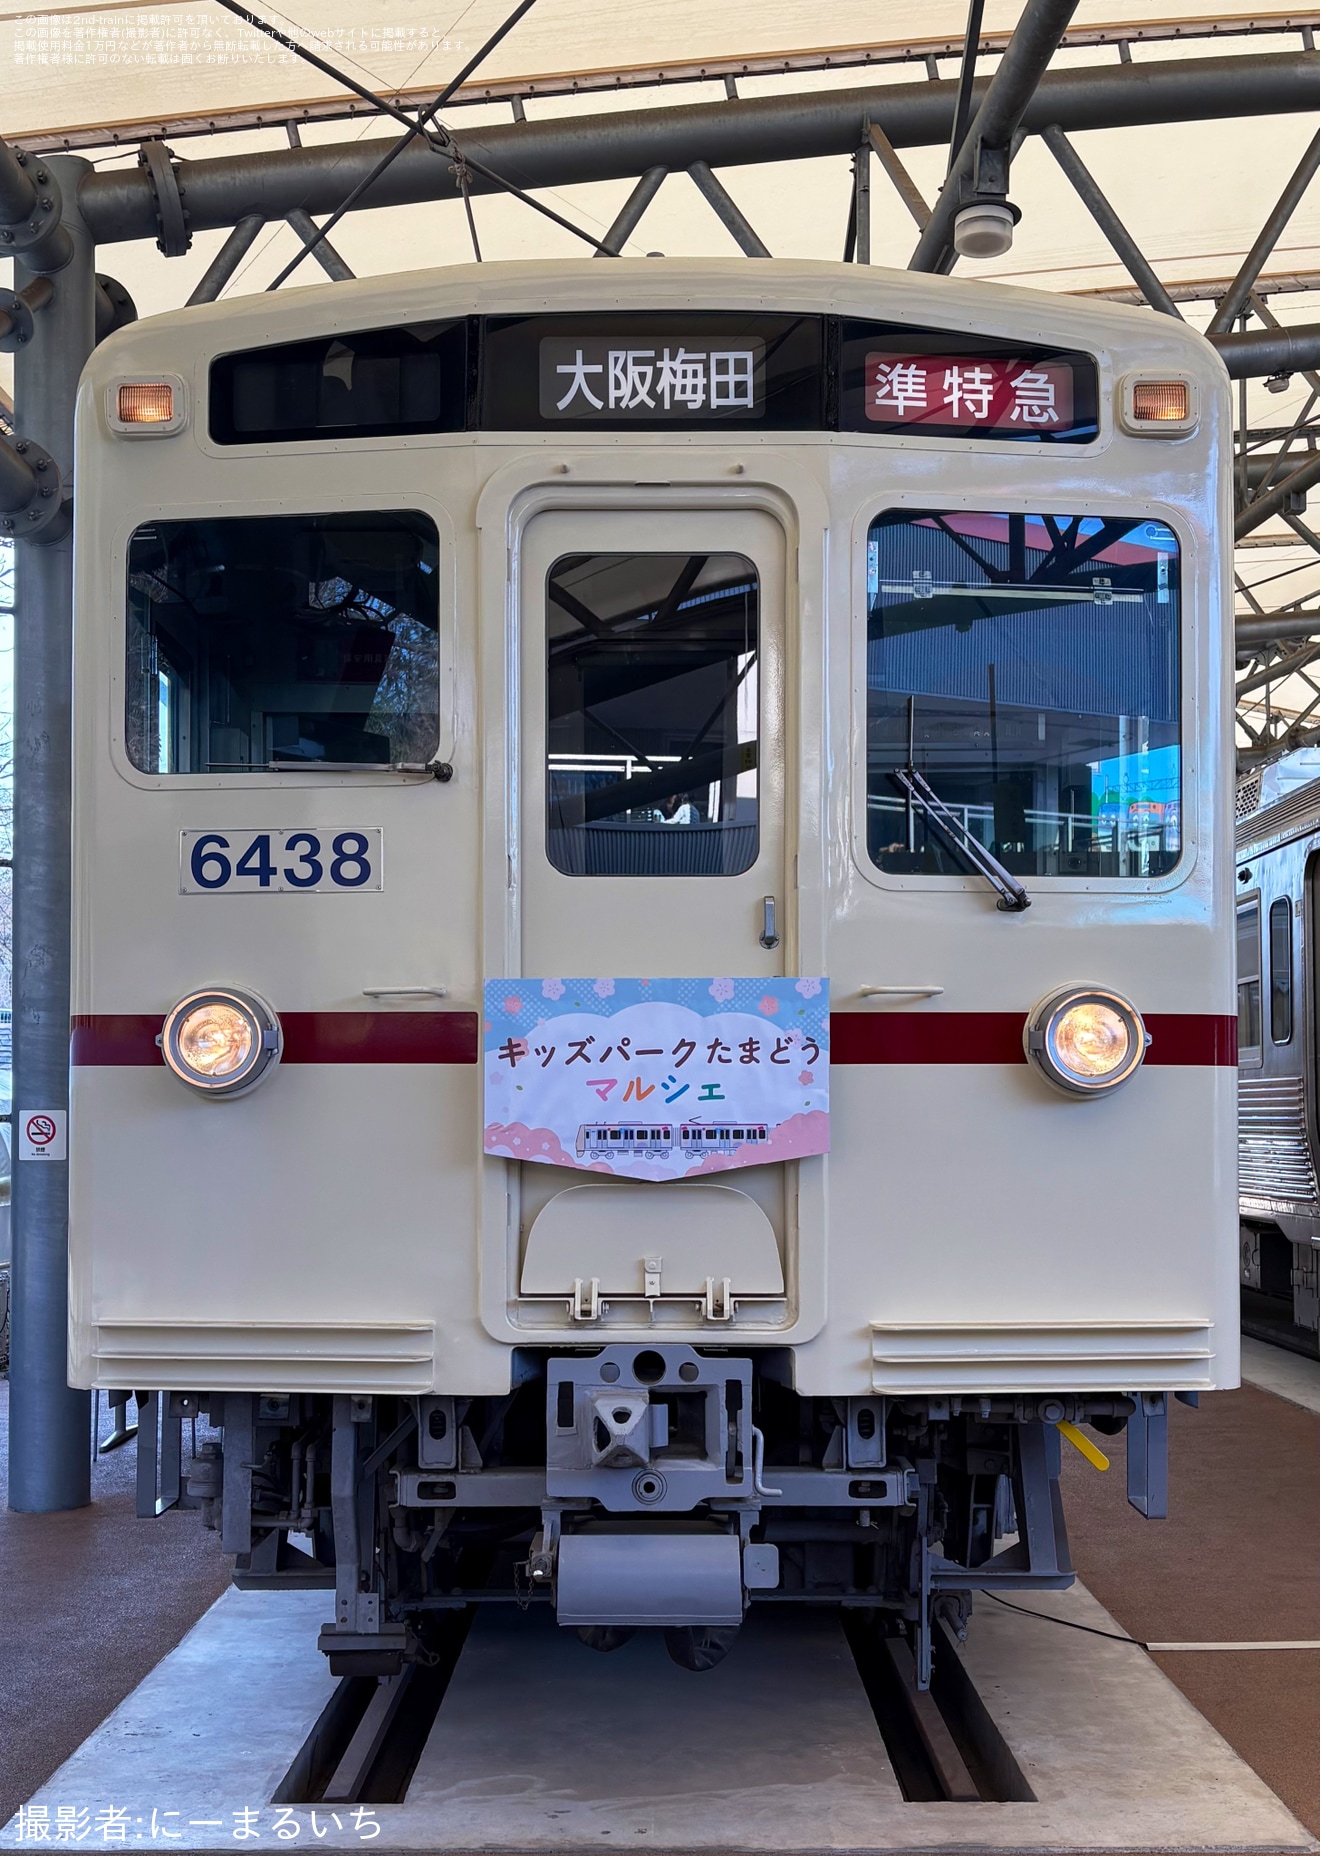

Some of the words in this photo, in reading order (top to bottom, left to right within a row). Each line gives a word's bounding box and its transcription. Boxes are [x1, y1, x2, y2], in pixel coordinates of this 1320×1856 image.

[556, 348, 754, 411] 大阪梅田
[875, 363, 1060, 424] 準特急
[190, 832, 371, 888] 6438
[498, 1035, 821, 1068] キッズパークたまどう
[586, 1075, 726, 1104] マルシェ
